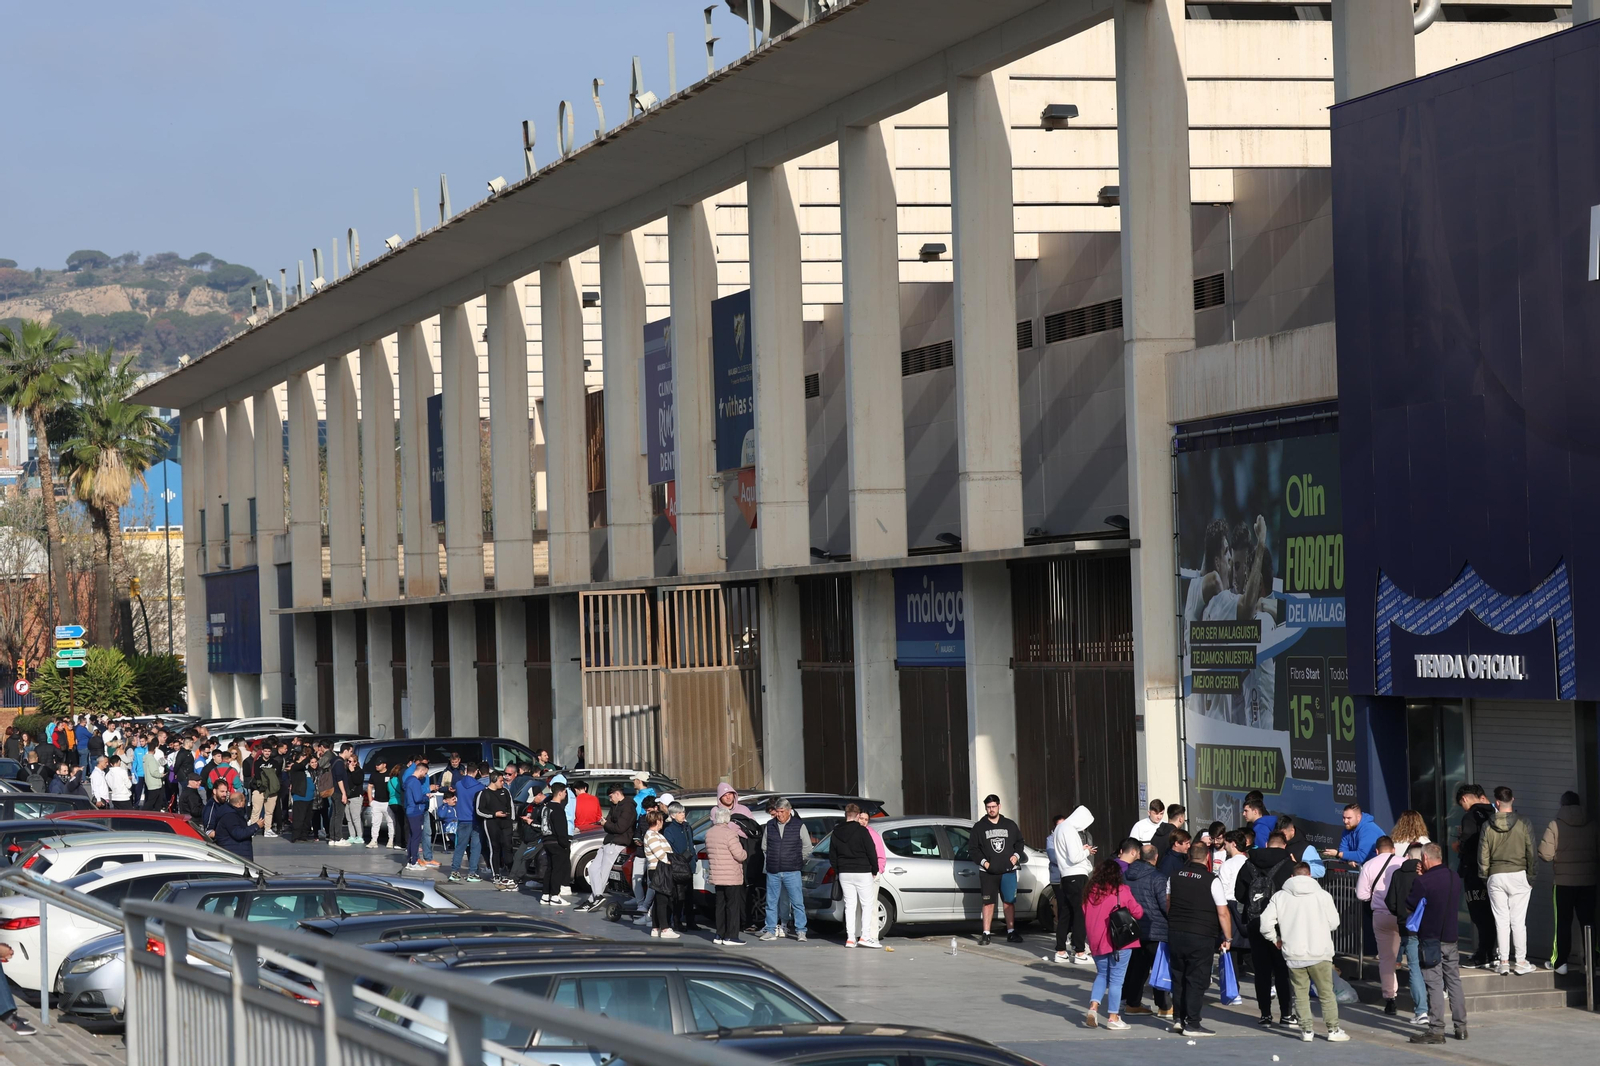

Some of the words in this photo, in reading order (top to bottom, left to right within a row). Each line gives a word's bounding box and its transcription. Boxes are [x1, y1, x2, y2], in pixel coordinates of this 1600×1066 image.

[1286, 473, 1326, 518] Olin
[1285, 533, 1344, 591] FOROFO
[1288, 604, 1306, 622] DEL
[1191, 627, 1205, 640] POR
[1205, 627, 1218, 640] SER
[1218, 625, 1261, 642] MALAGUISTA,
[1193, 651, 1201, 664] TE
[1201, 651, 1224, 665] DAMOS
[1225, 651, 1254, 664] NUESTRA
[1414, 654, 1465, 679] TIENDA
[1467, 653, 1523, 680] OFICIAL
[1290, 667, 1305, 680] Fibra
[1305, 667, 1320, 680] Start
[1330, 667, 1345, 680] Todo
[1193, 675, 1214, 689] MEJOR
[1214, 676, 1240, 690] OFERTA
[1290, 694, 1314, 740] 15
[1331, 695, 1355, 742] 19
[1213, 748, 1231, 787] POR
[1232, 748, 1277, 790] USTEDES!
[1293, 757, 1314, 770] 300Mb
[1337, 783, 1354, 797] 20GB
